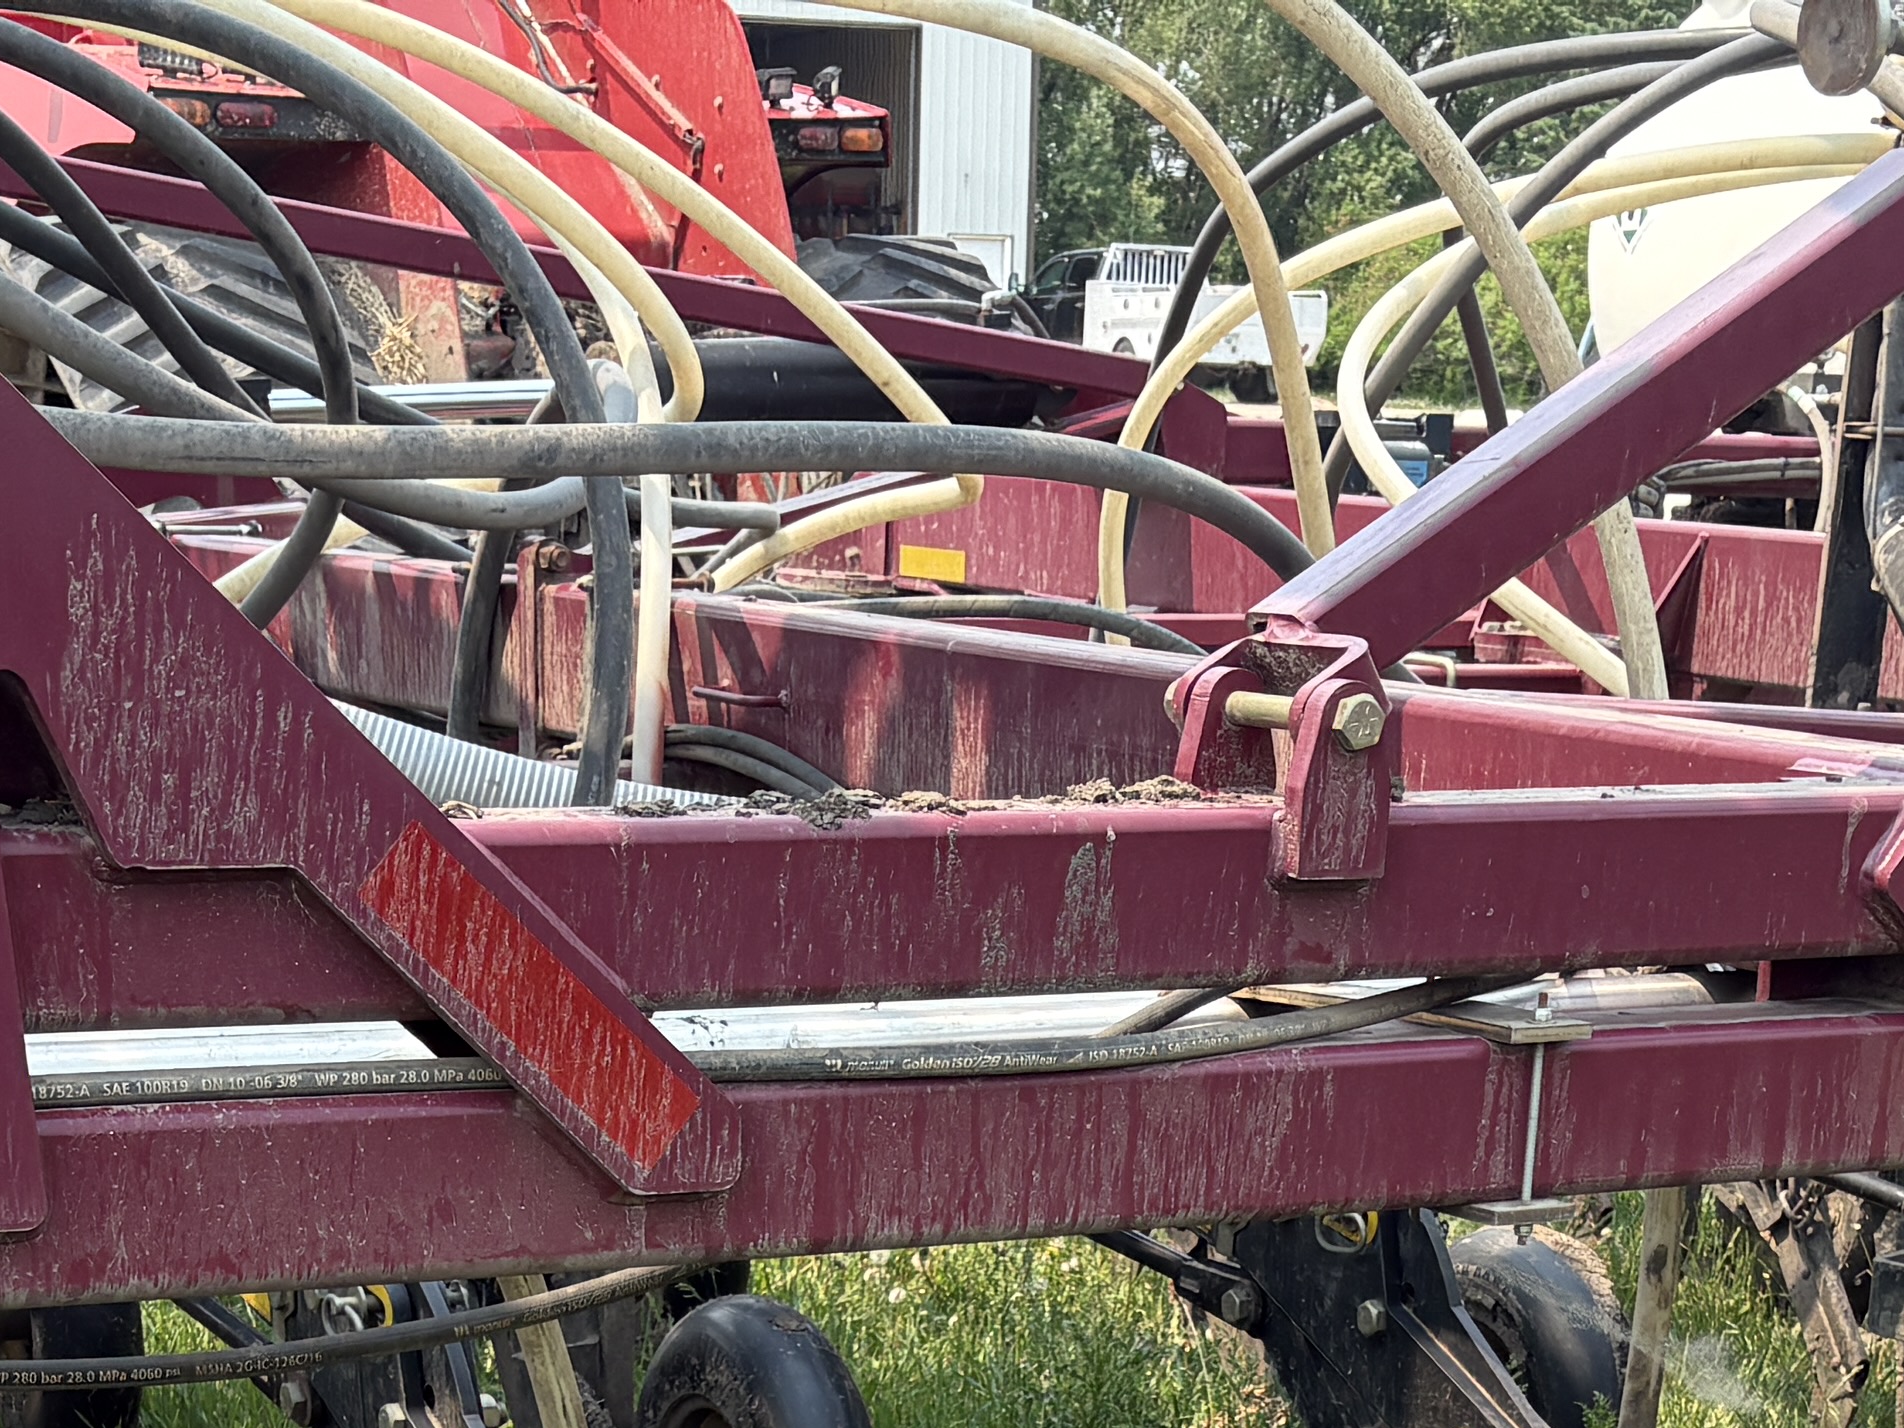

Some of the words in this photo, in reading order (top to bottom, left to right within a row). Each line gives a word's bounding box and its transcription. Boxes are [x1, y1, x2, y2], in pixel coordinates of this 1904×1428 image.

[103, 1083, 130, 1096] SAE
[136, 1079, 188, 1095] 100R19
[202, 1078, 223, 1091] DN
[229, 1077, 245, 1090] 10
[315, 1071, 338, 1087] WP
[342, 1071, 368, 1085] 280
[372, 1069, 396, 1085] bar
[400, 1069, 429, 1084] 28.0
[434, 1069, 463, 1083] MPa
[12, 1371, 37, 1385] 280
[41, 1369, 64, 1384] bar
[66, 1369, 95, 1383] 28.0
[99, 1368, 127, 1382] MPa
[130, 1367, 163, 1380] 4060
[166, 1367, 181, 1379] psi
